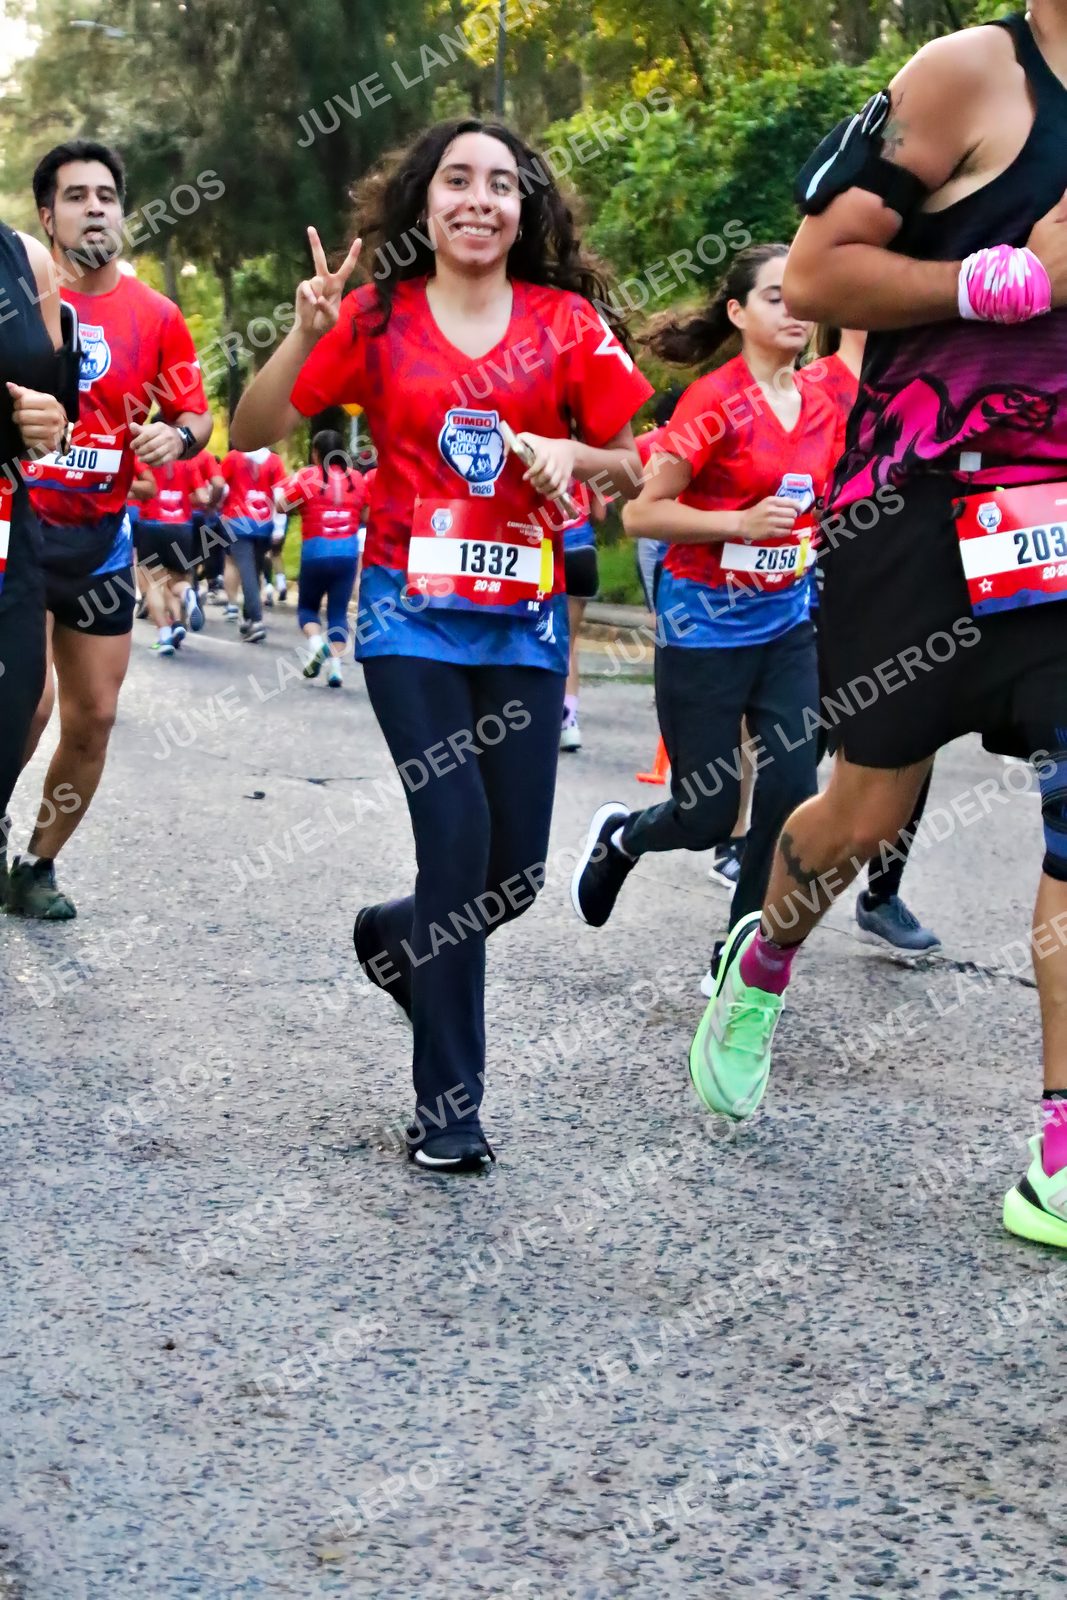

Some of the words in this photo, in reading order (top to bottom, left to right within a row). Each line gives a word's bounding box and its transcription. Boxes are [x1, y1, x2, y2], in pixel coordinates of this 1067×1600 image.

[453, 416, 492, 427] BIMBO
[456, 430, 492, 445] Global
[450, 442, 478, 455] Race
[472, 485, 492, 494] 2026
[1013, 526, 1067, 565] 203
[460, 542, 518, 577] 1332
[755, 548, 798, 570] 2058
